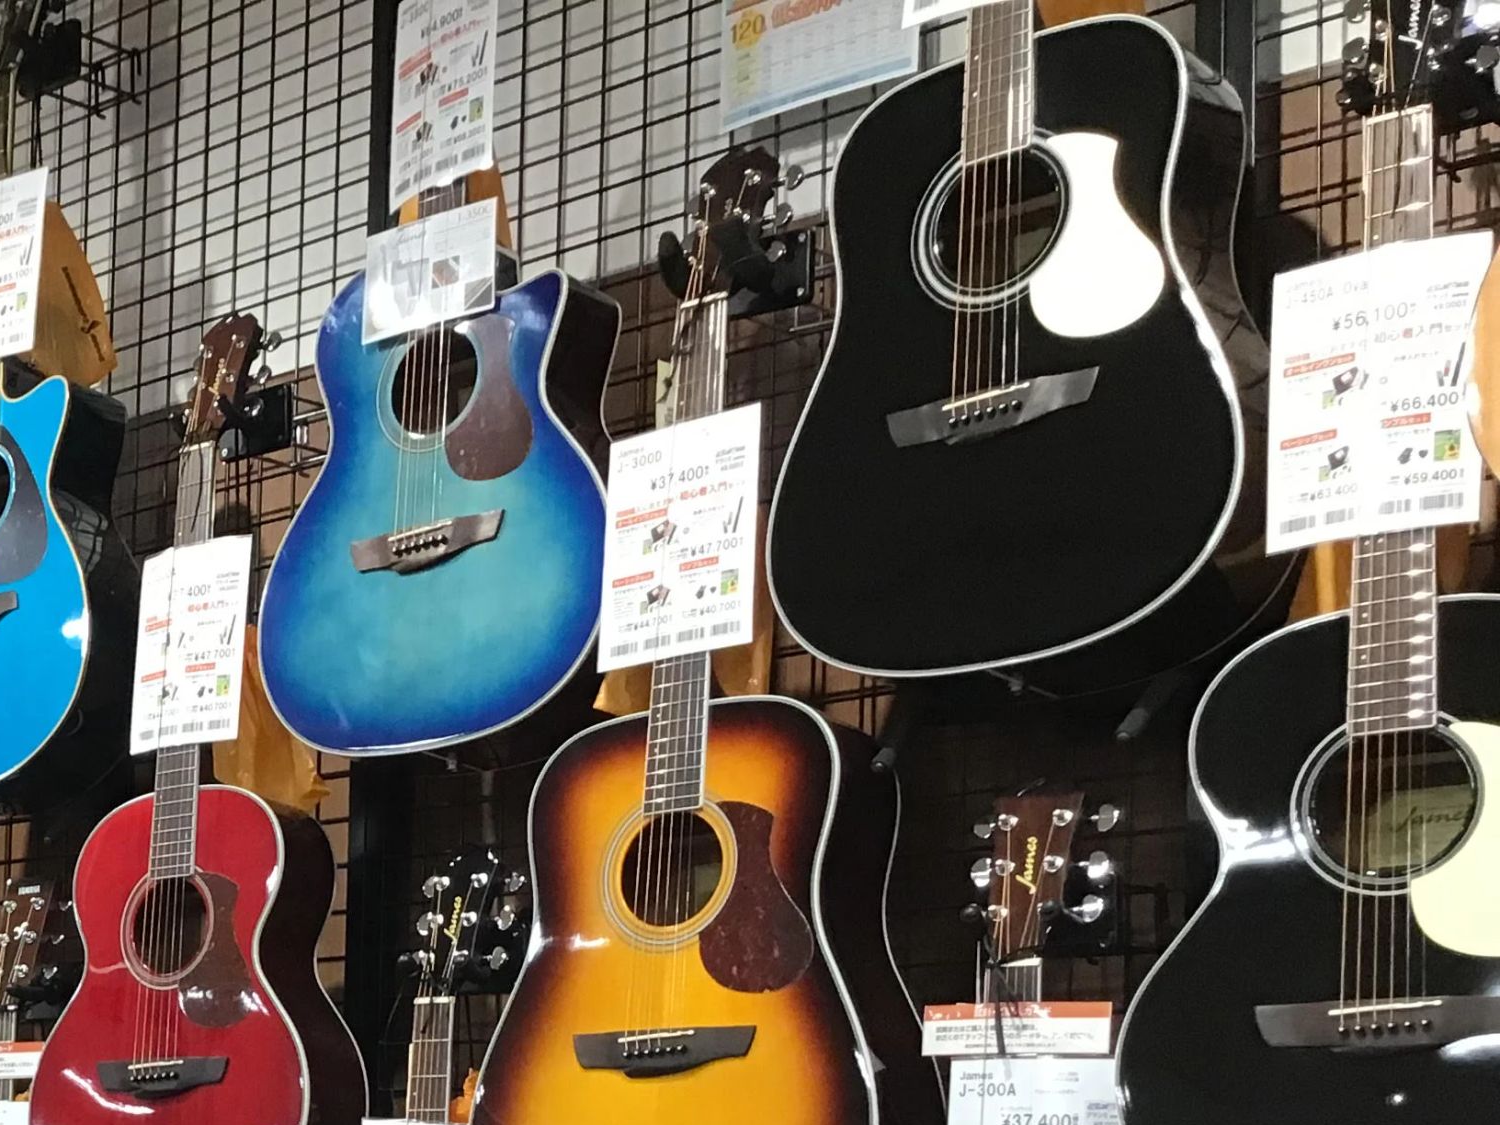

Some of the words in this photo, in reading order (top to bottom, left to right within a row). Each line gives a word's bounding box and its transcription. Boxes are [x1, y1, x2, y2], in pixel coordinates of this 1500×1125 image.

[730, 14, 766, 44] 120
[1390, 391, 1460, 413] ¥66,400
[1388, 805, 1467, 834] Jame
[1015, 836, 1038, 895] James
[959, 1071, 994, 1081] James
[959, 1083, 1017, 1098] J-300A
